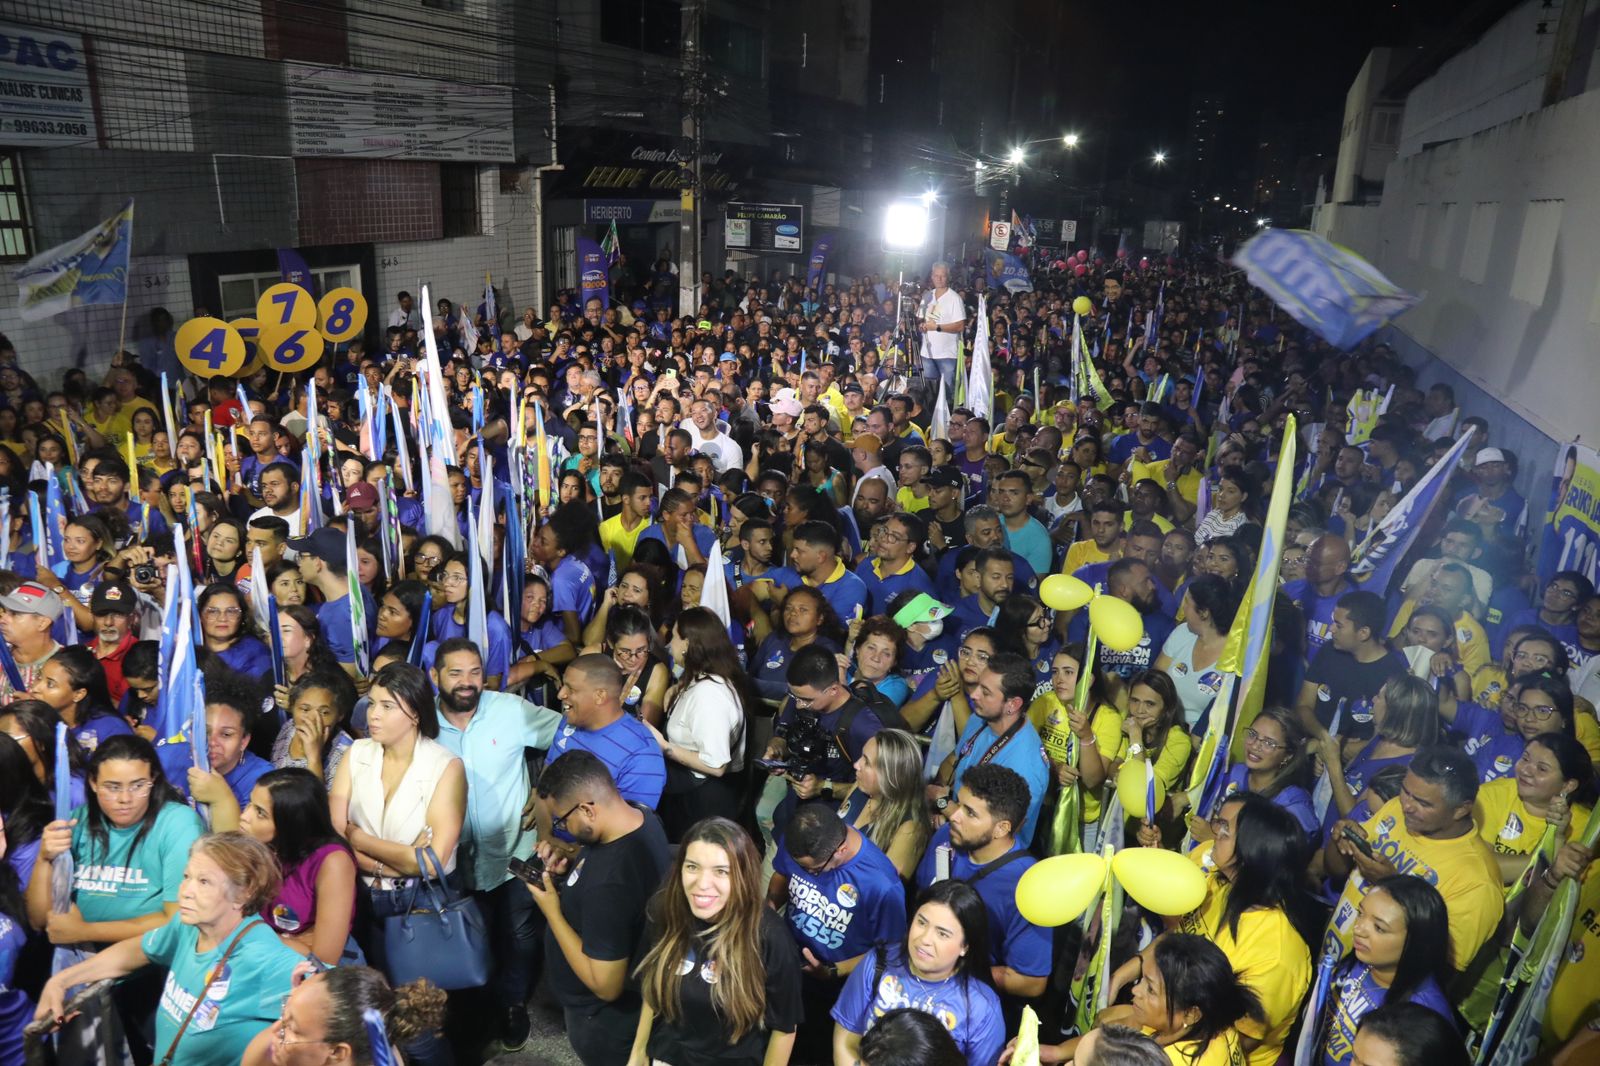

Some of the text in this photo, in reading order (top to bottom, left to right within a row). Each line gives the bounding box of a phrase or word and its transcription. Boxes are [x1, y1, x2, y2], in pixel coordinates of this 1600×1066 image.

[631, 146, 666, 161] Centro
[583, 166, 647, 188] FELIPE
[590, 206, 632, 219] HERIBERTO
[272, 290, 299, 324] 7
[325, 298, 355, 335] 8
[189, 328, 228, 370] 4
[274, 330, 310, 364] 6
[1100, 645, 1151, 659] ROON
[1100, 655, 1150, 666] CARVALHO
[73, 879, 118, 893] NDALL
[788, 877, 854, 926] ROBSON
